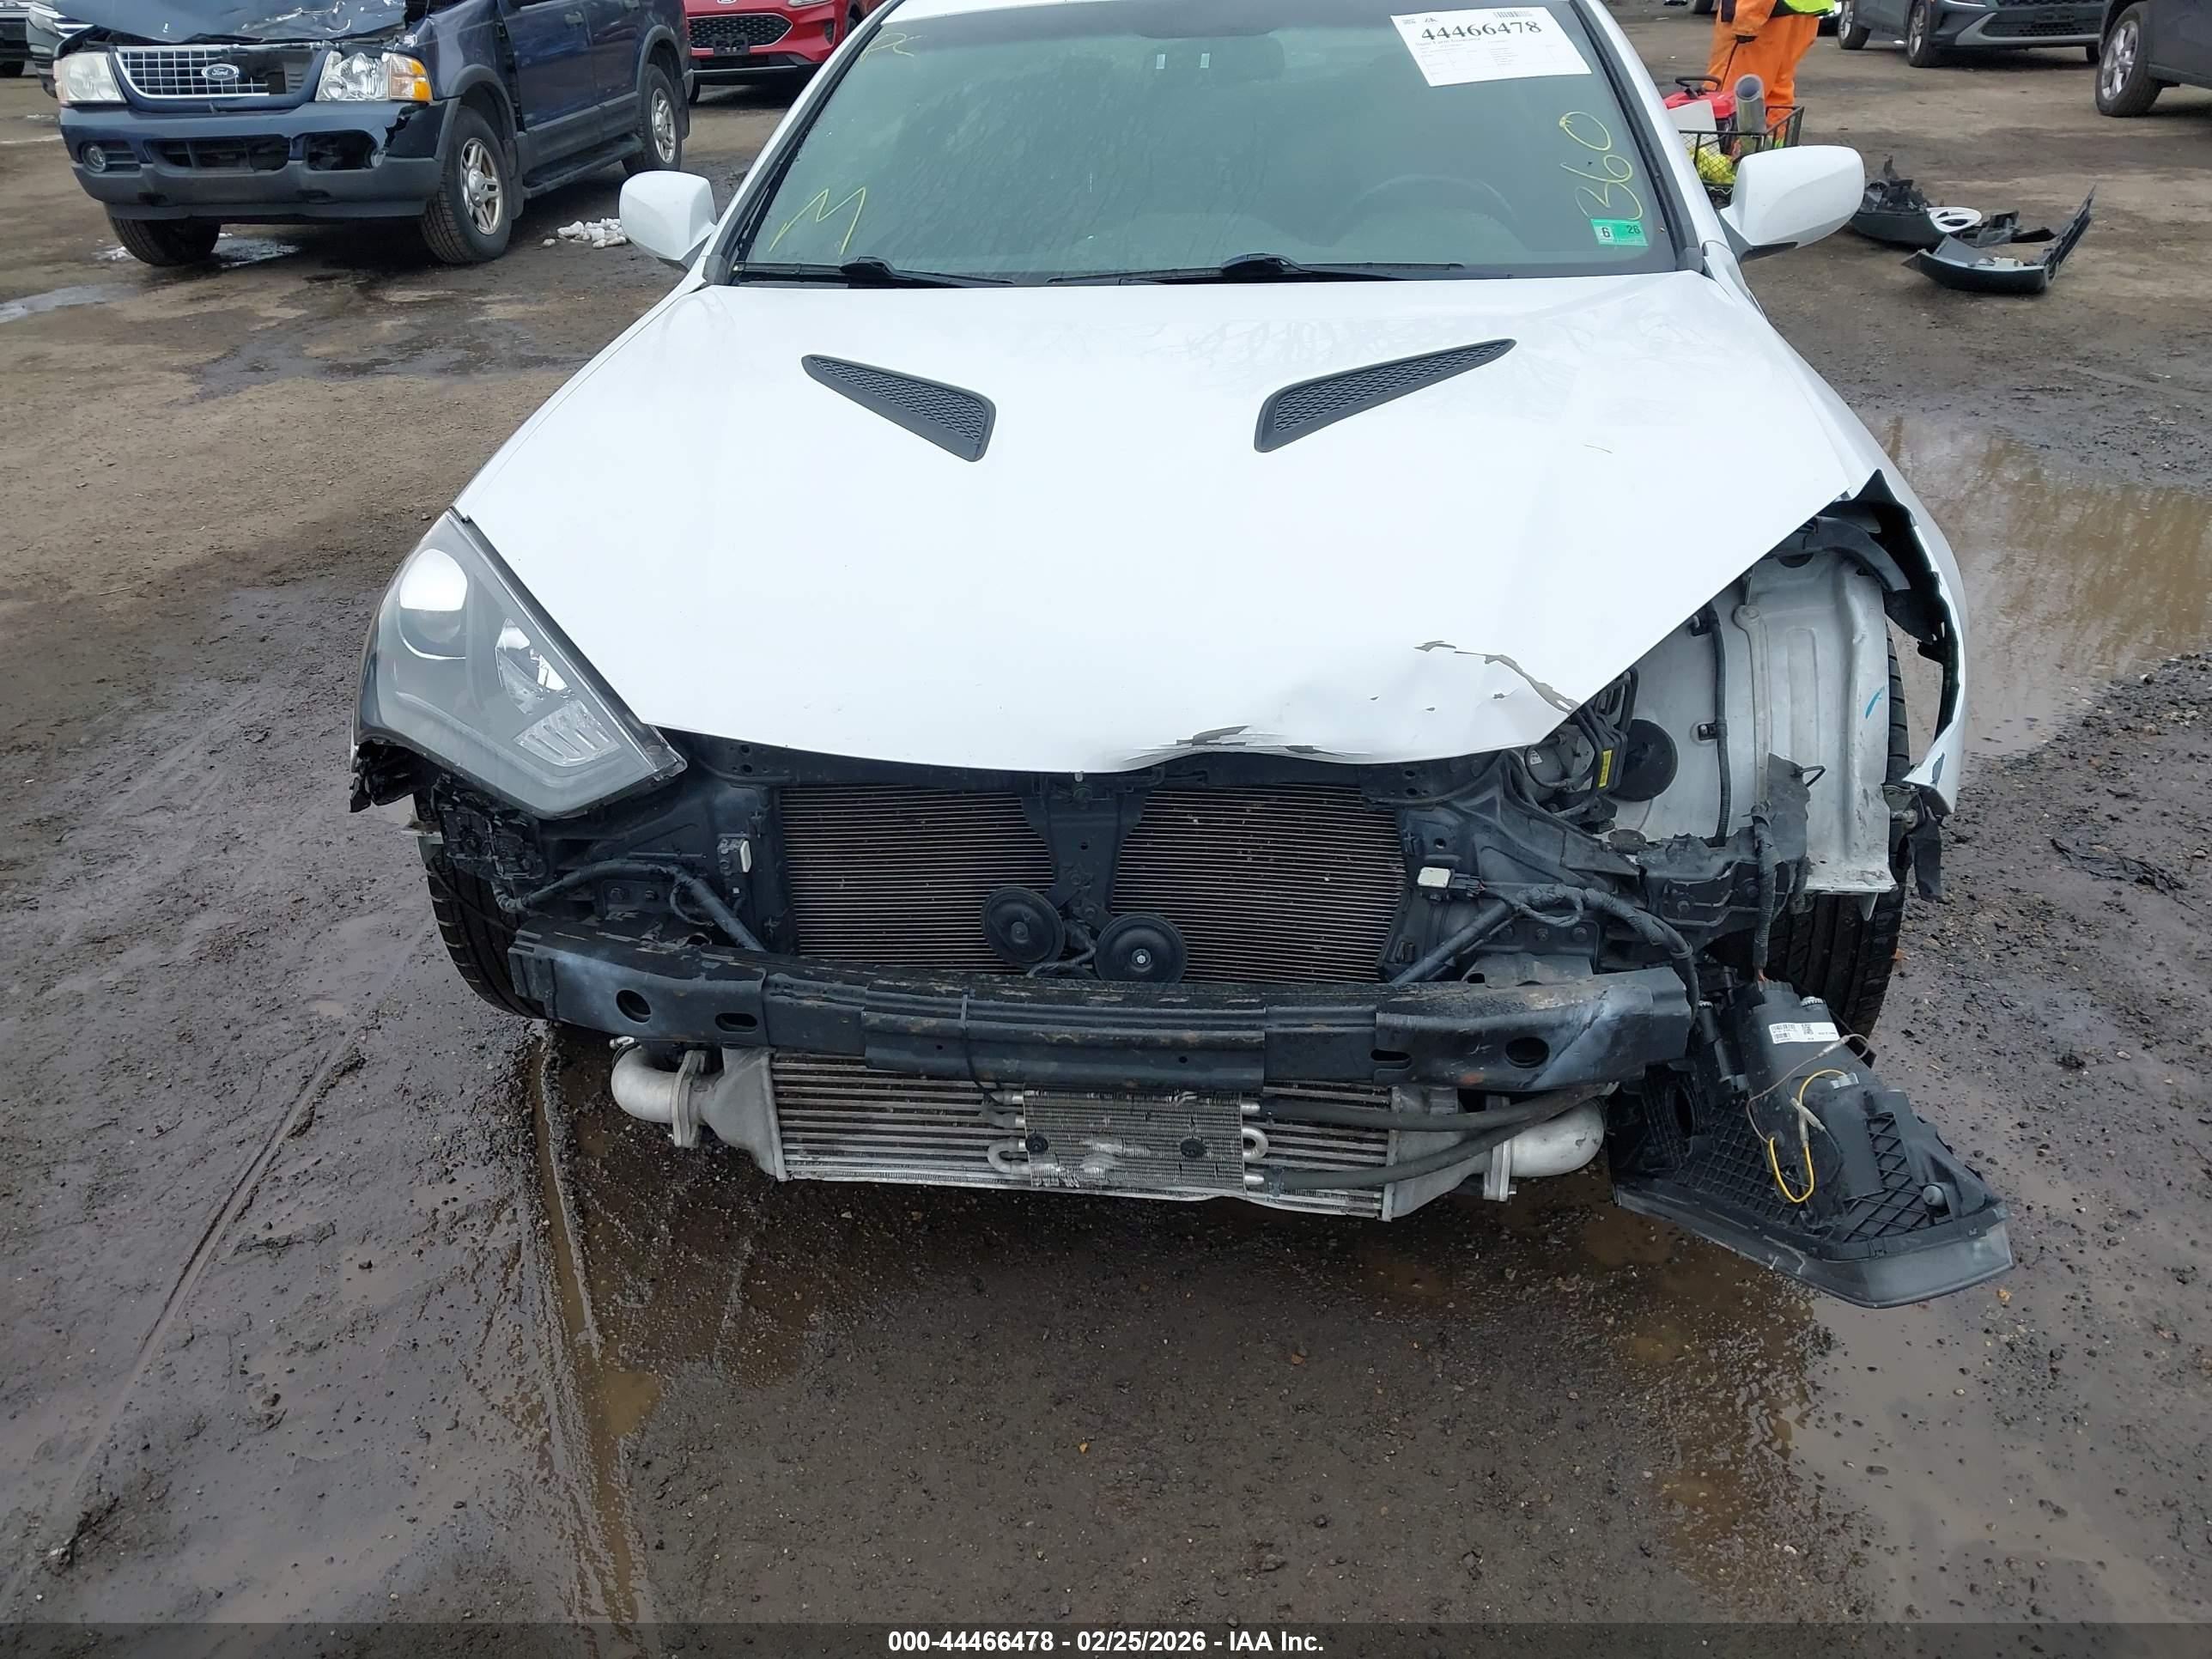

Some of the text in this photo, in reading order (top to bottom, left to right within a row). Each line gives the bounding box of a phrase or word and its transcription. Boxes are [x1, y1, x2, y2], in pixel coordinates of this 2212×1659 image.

[1421, 21, 1542, 40] 44466478
[1559, 111, 1644, 221] 360
[769, 186, 866, 257] M
[1601, 224, 1641, 238] 6 26
